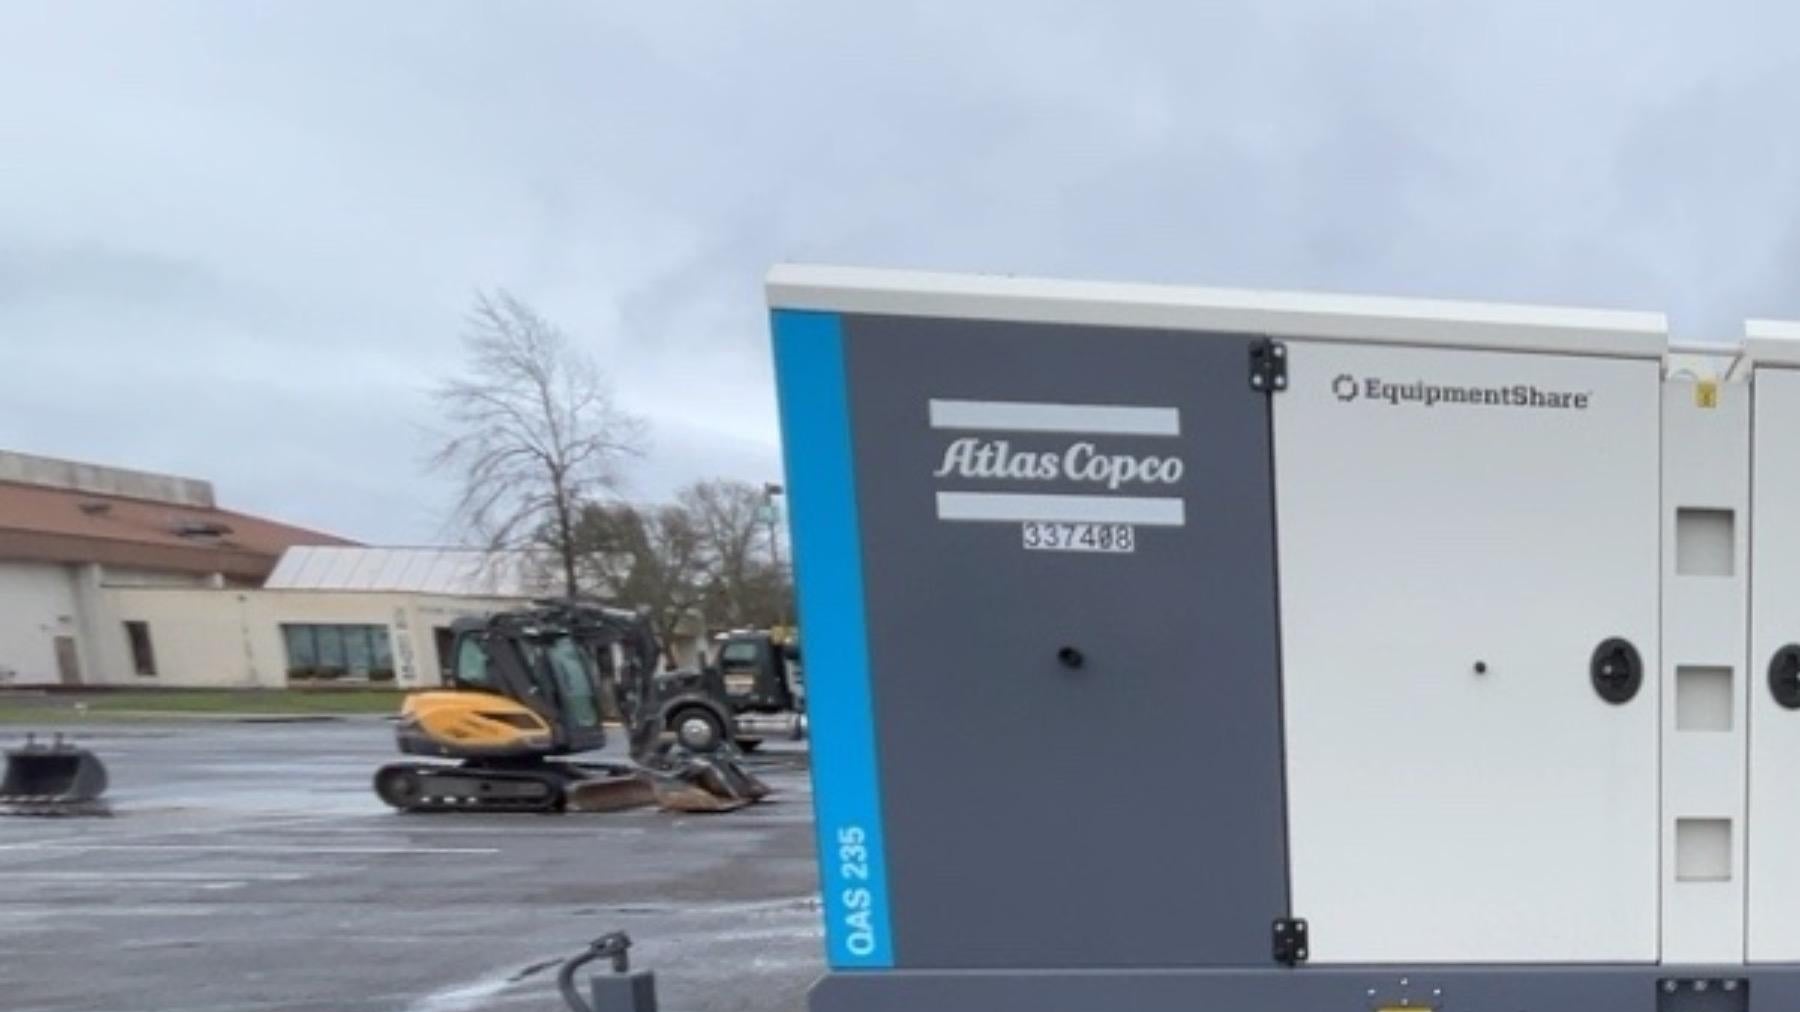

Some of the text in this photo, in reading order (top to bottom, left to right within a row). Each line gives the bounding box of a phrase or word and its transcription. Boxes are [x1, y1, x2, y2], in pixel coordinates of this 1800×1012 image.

[1363, 377, 1590, 409] EquipmentShare
[932, 437, 1184, 490] Atlas Copco
[1024, 521, 1134, 551] 337408
[836, 826, 869, 881] 235
